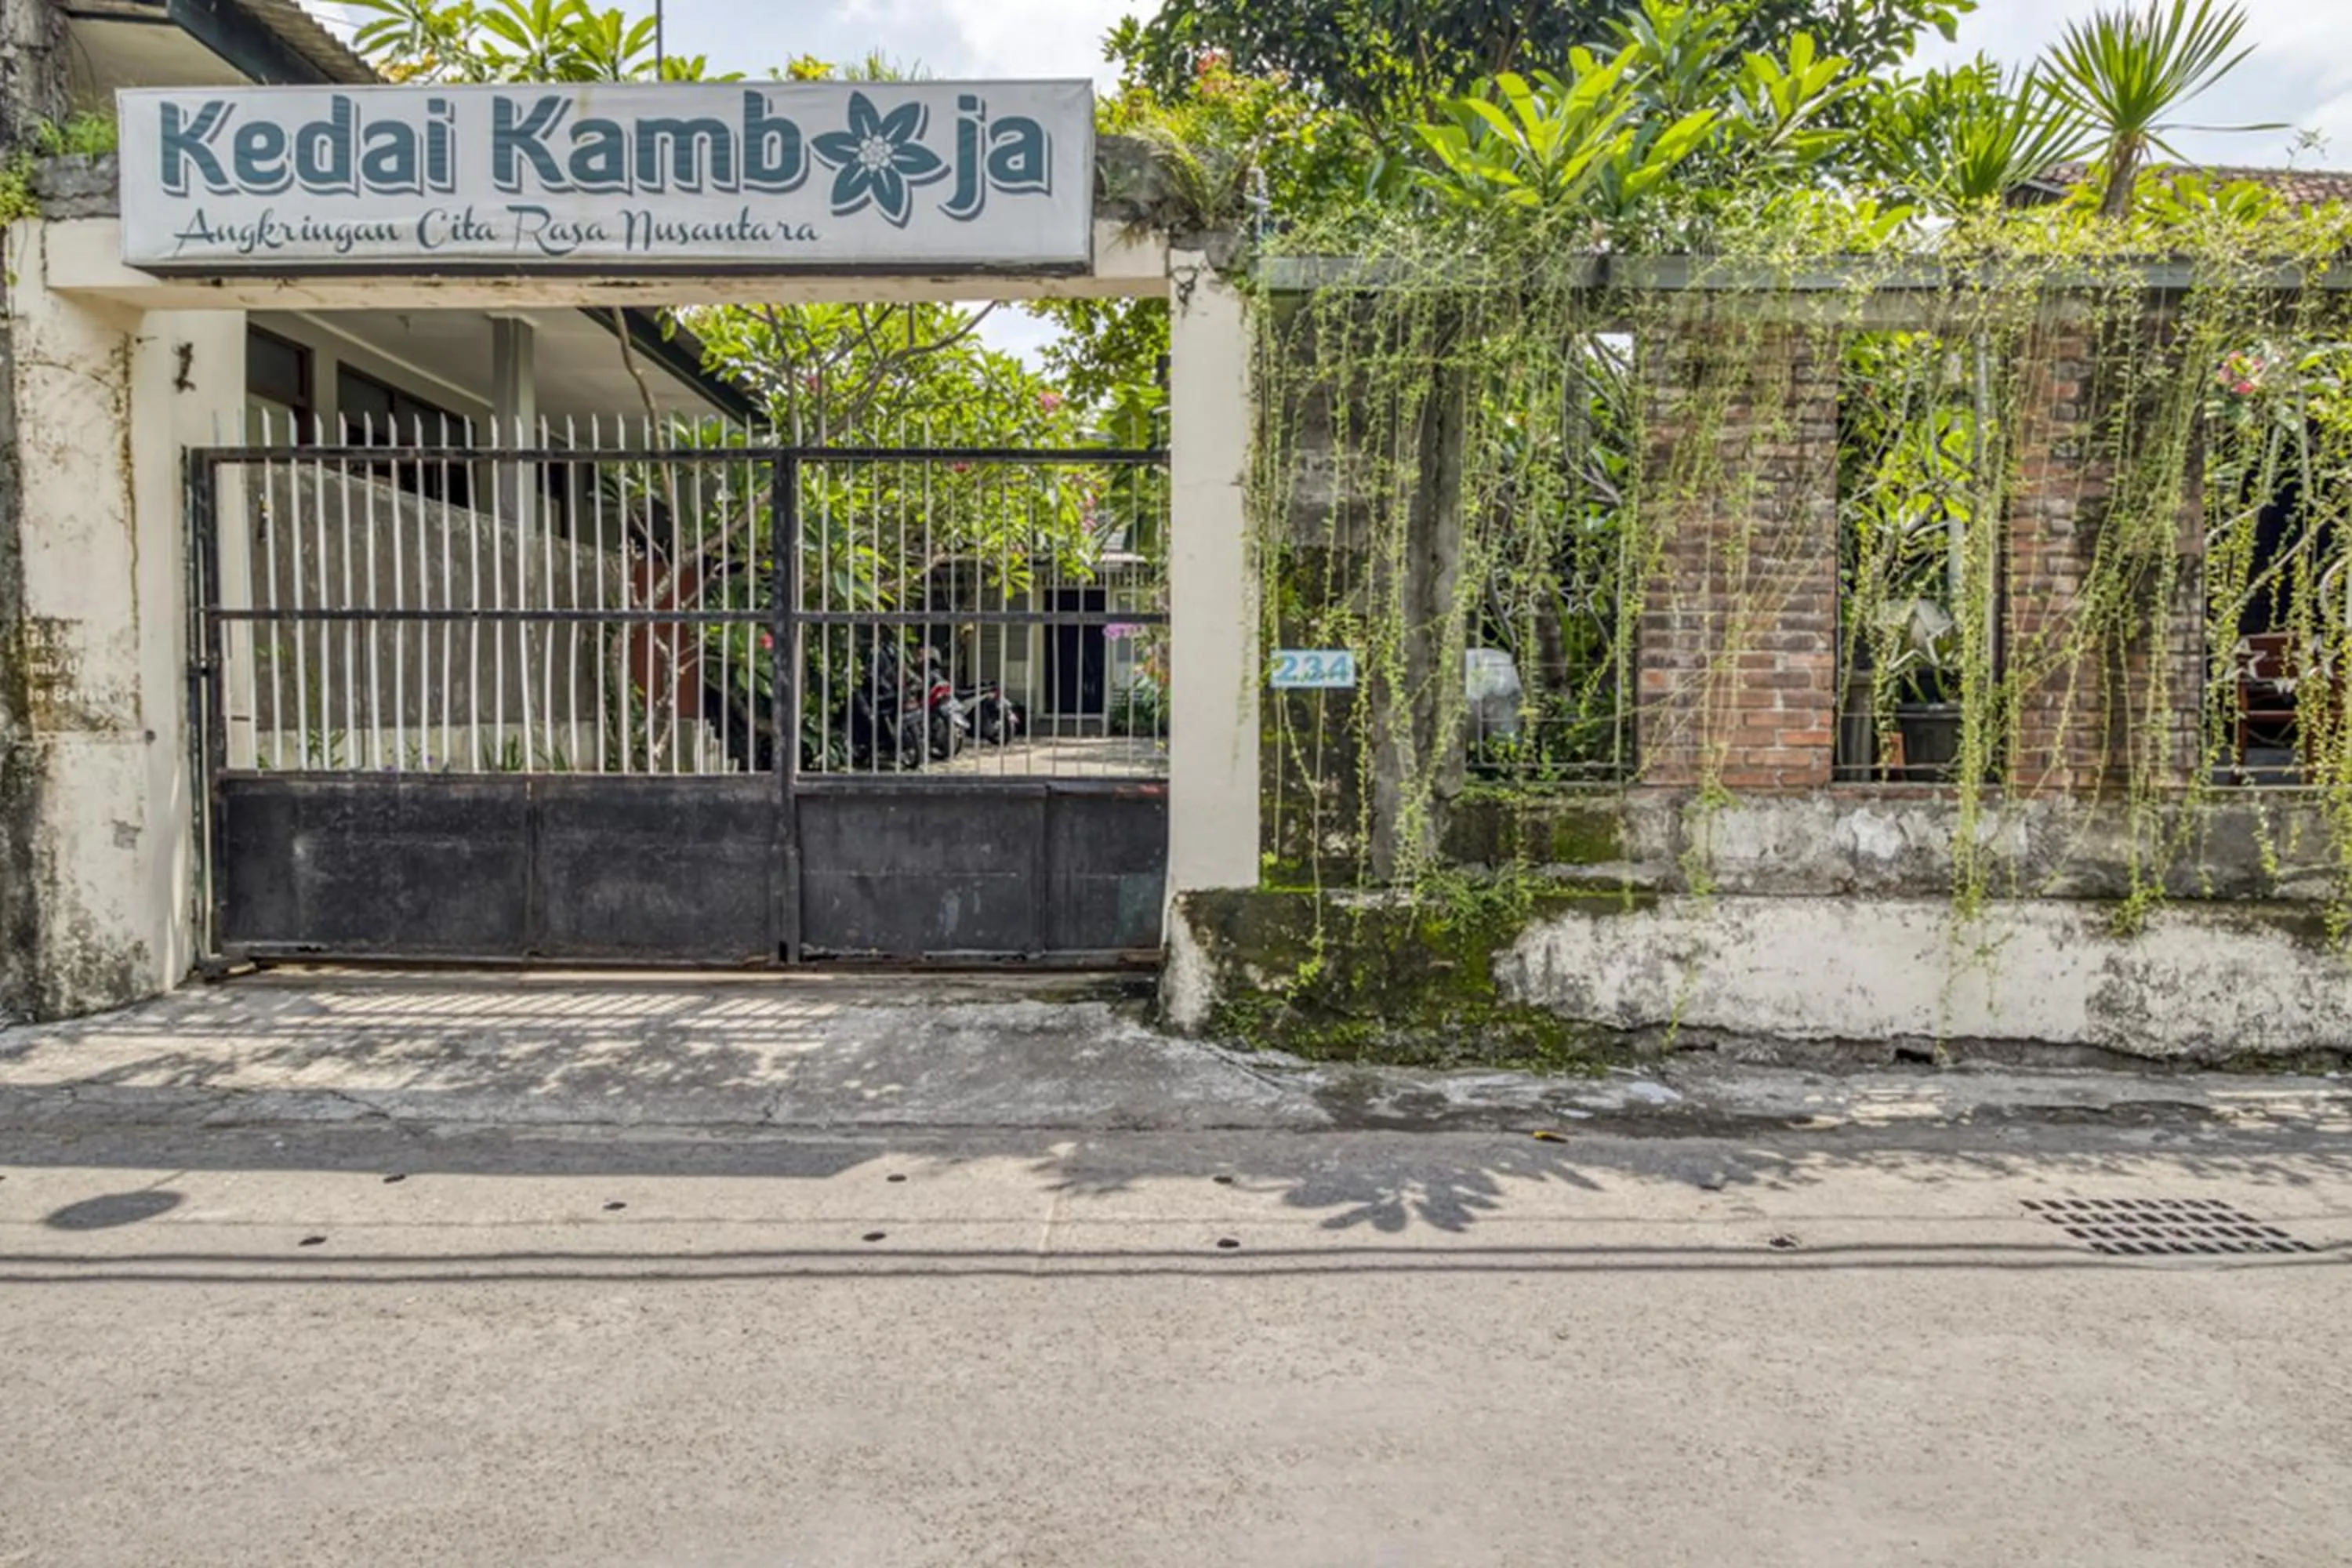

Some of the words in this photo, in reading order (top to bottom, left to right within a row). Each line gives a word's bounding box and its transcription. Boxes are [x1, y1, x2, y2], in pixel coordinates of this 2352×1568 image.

[159, 93, 456, 198] Kedai
[172, 206, 400, 254] Angkringan
[416, 207, 498, 252] Cita
[505, 205, 608, 257] Rasa
[615, 204, 821, 252] Nusantara
[1276, 655, 1350, 683] 234
